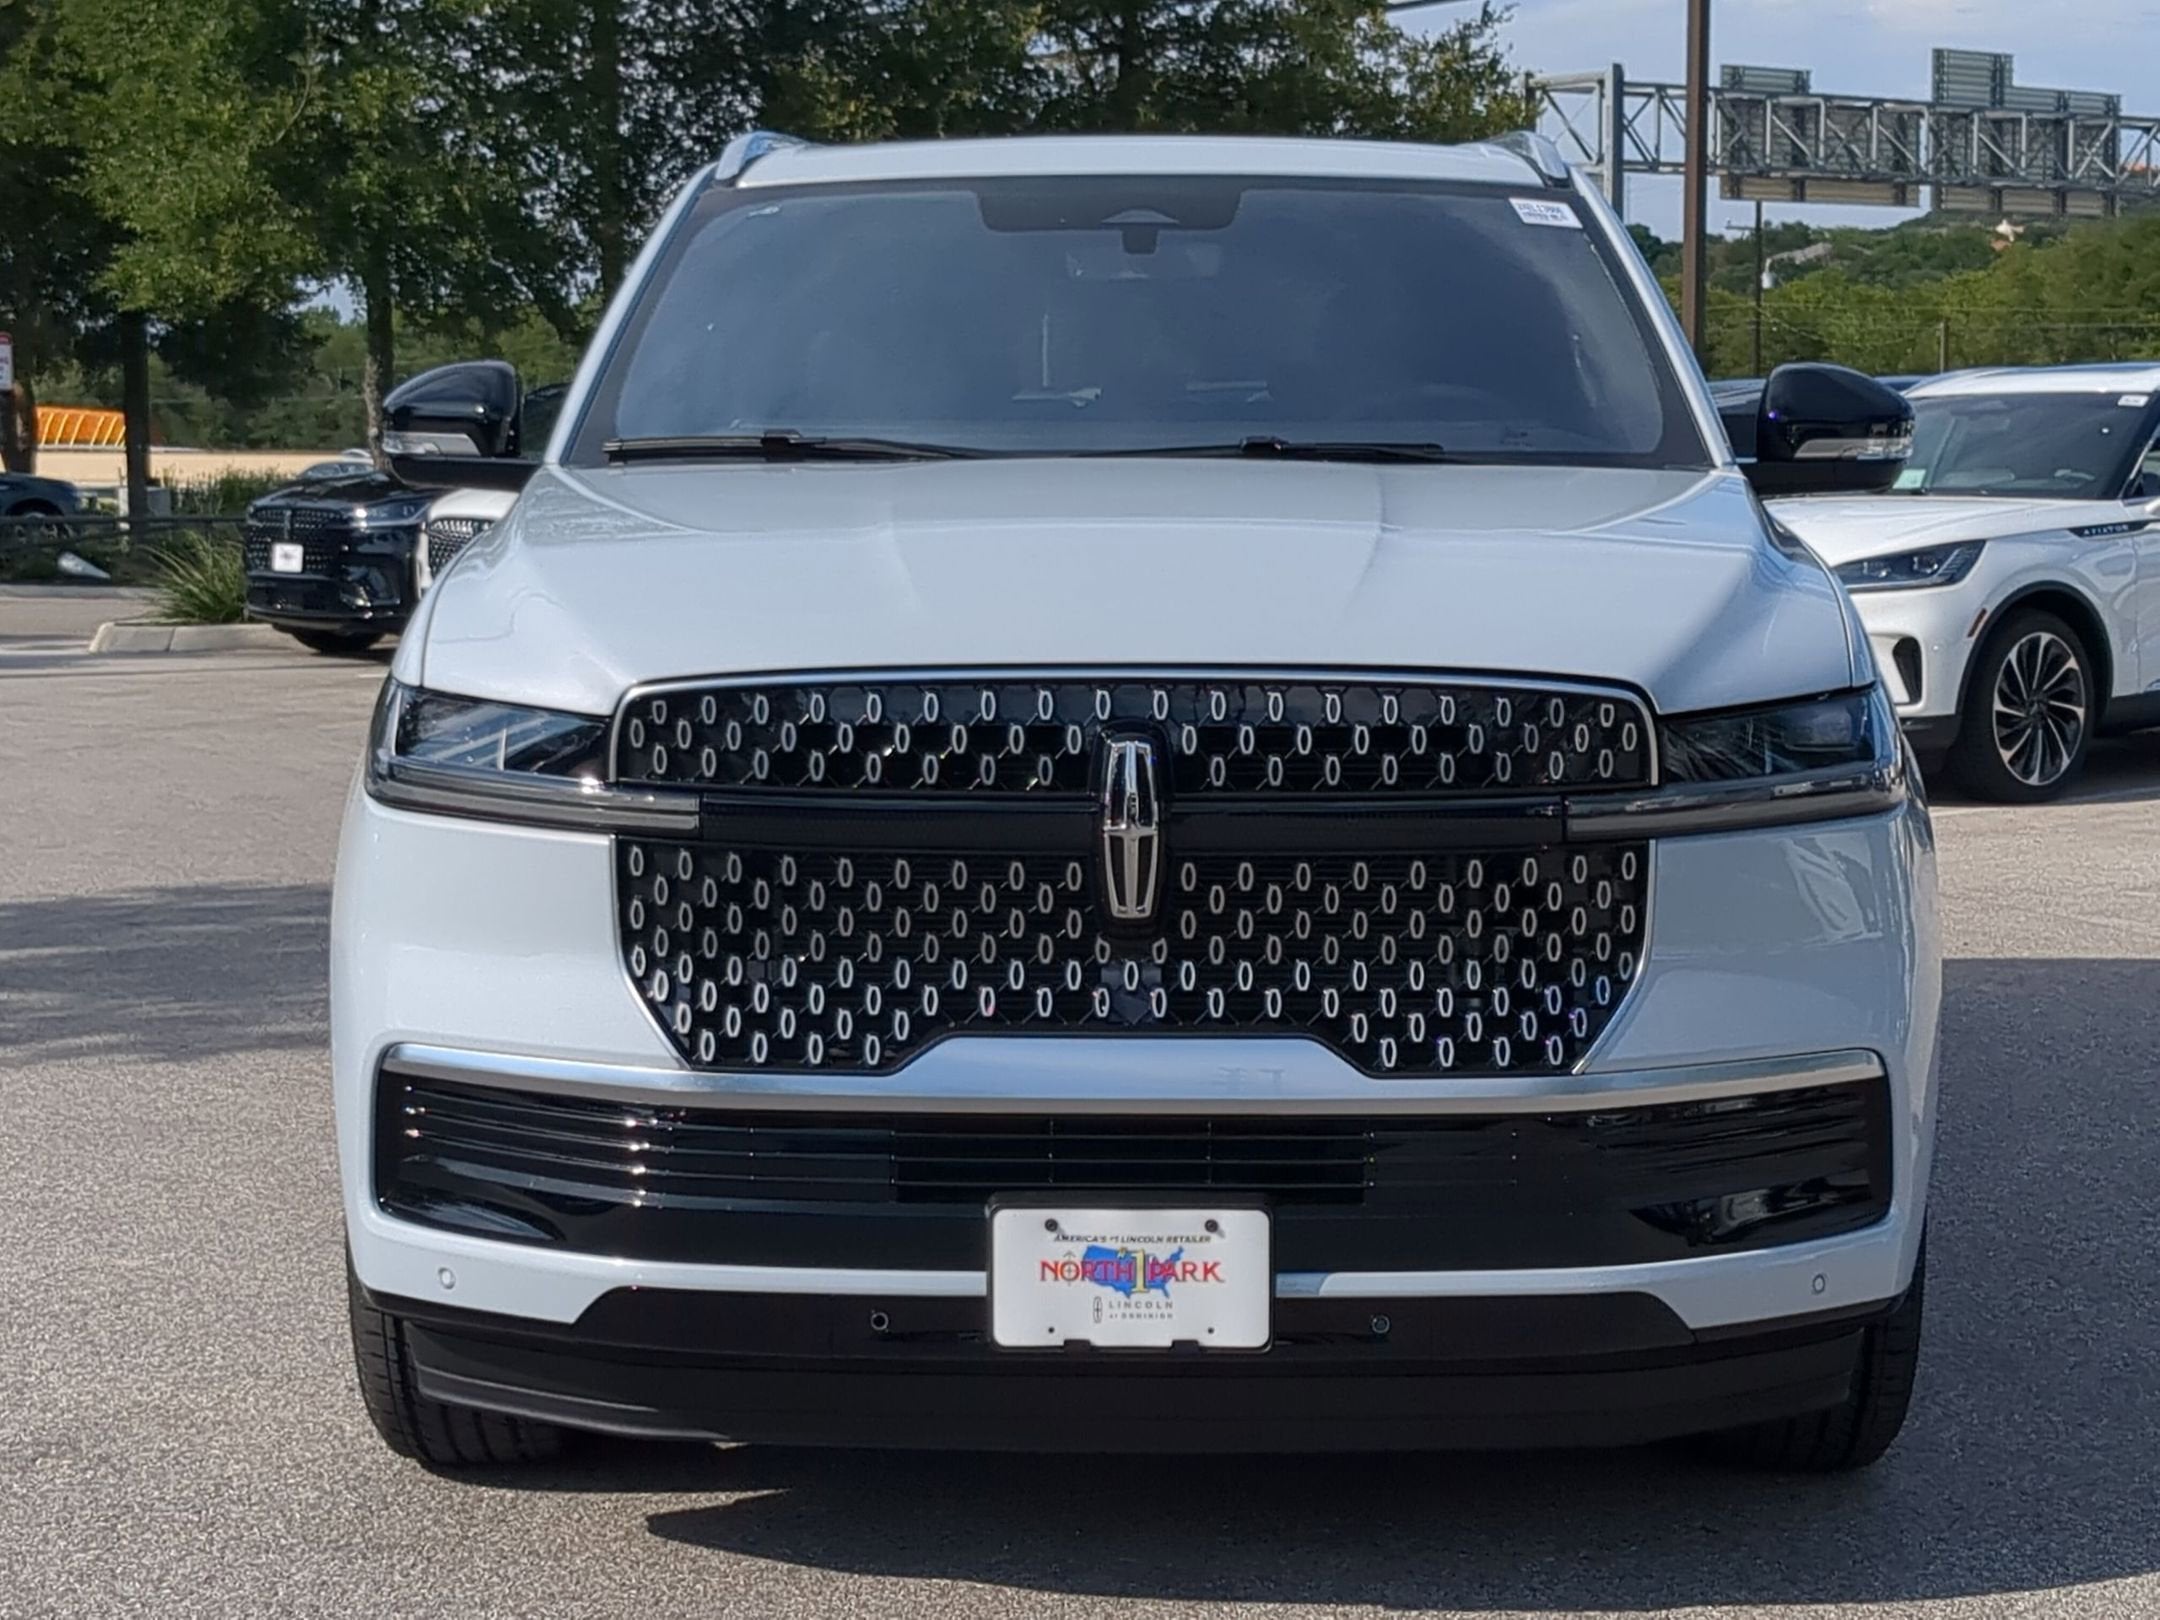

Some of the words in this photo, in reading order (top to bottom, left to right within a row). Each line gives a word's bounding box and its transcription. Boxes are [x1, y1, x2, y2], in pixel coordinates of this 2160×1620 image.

[2083, 524, 2129, 535] AVIATOR
[1053, 1234, 1107, 1243] AMERICA'S
[1120, 1235, 1163, 1243] LINCOLN
[1165, 1235, 1211, 1243] RETAILER
[1040, 1260, 1135, 1282] NORTH
[1146, 1259, 1225, 1282] PARK
[1108, 1301, 1173, 1310] LINCOLN
